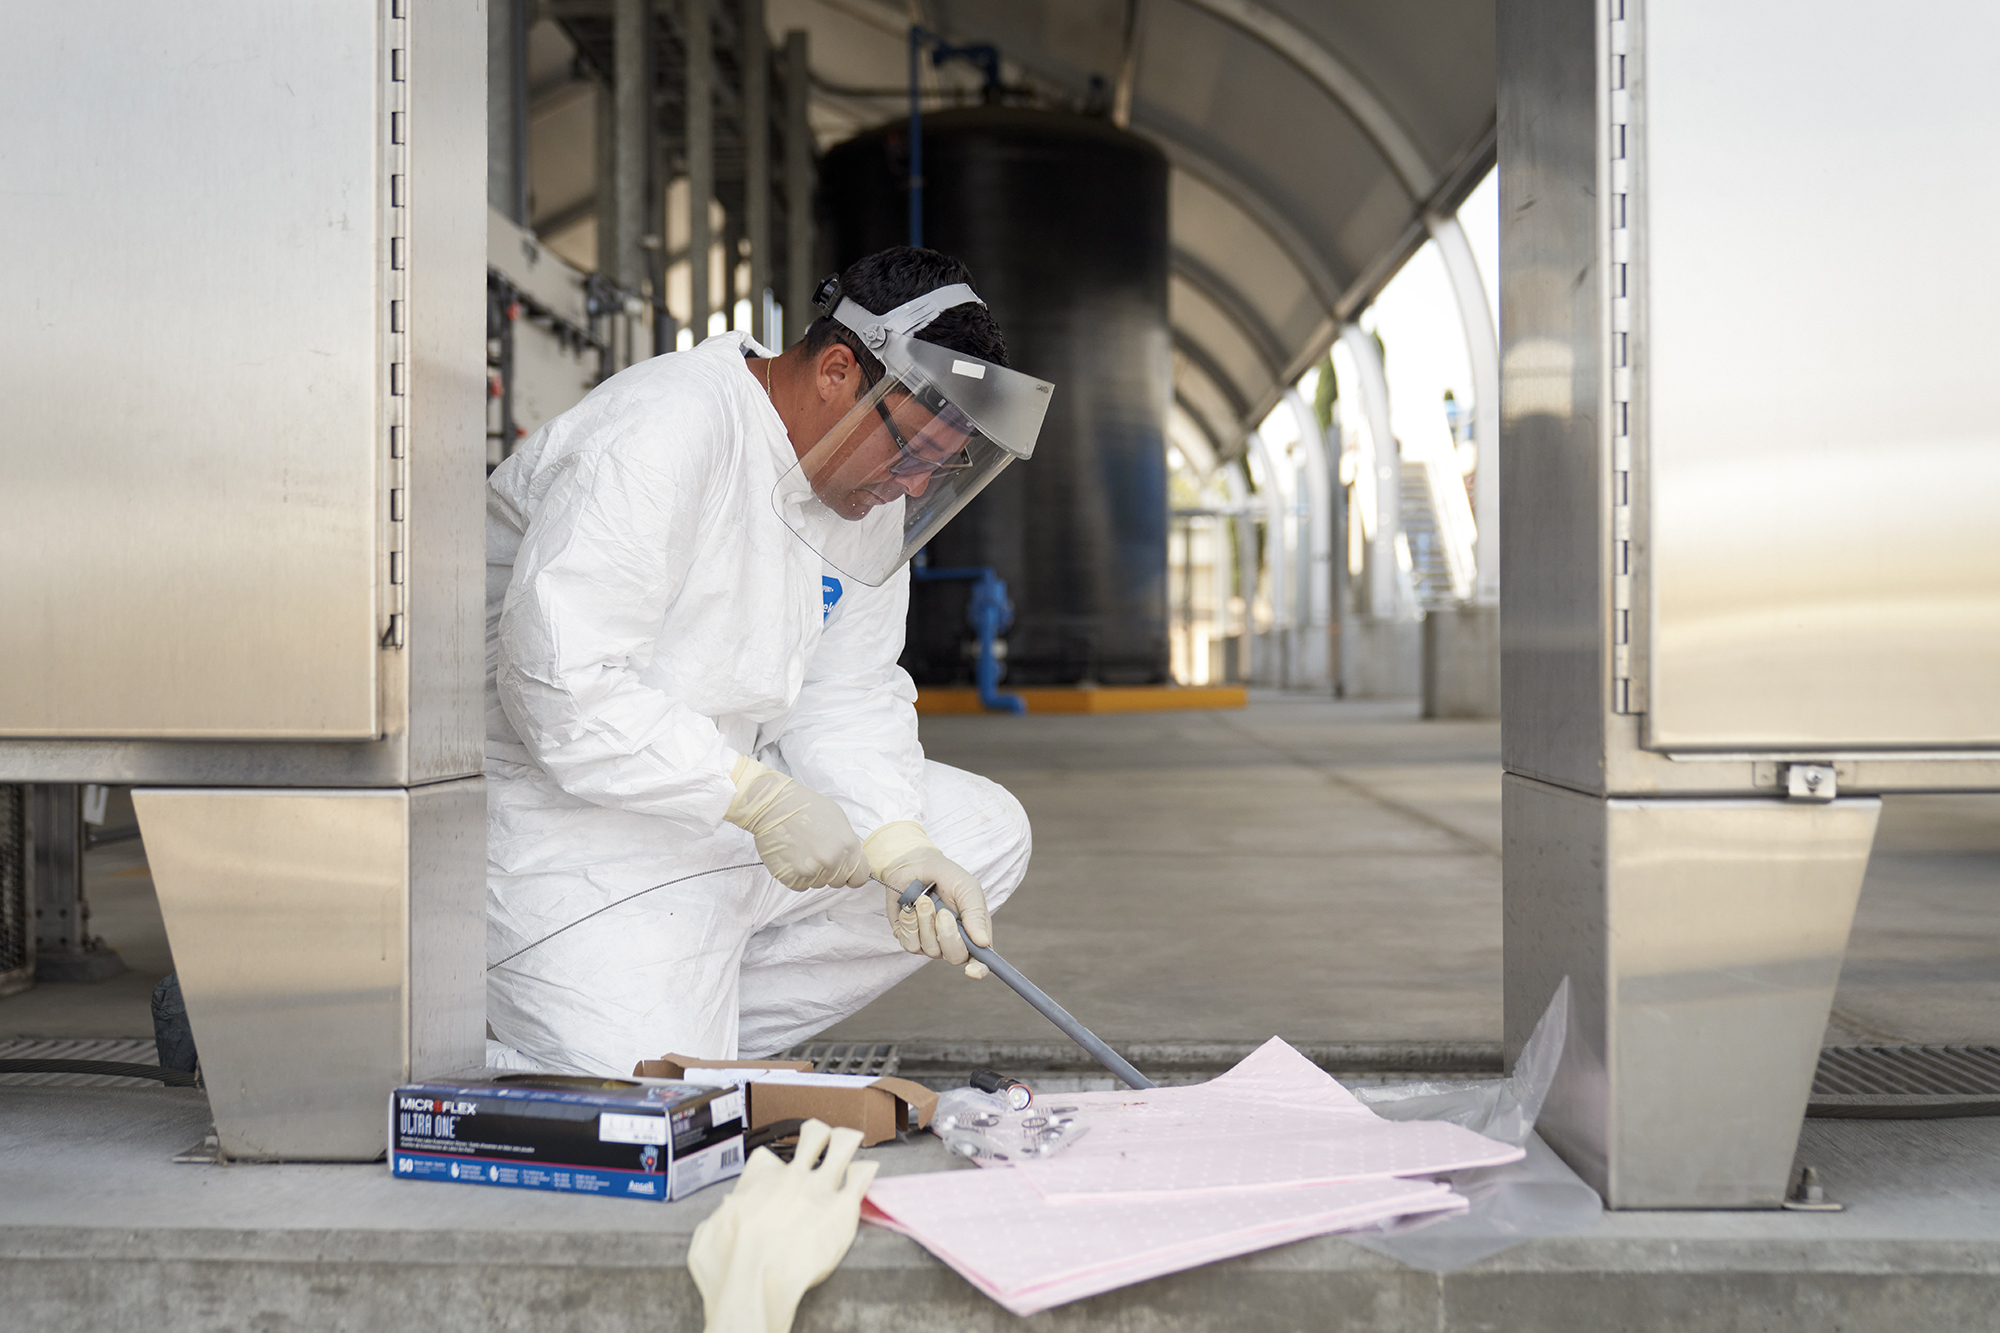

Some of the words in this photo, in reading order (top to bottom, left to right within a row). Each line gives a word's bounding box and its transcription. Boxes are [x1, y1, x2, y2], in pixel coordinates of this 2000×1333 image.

[400, 1112, 432, 1136] ULTRA
[434, 1114, 457, 1139] ONE
[628, 1180, 655, 1191] Ansell
